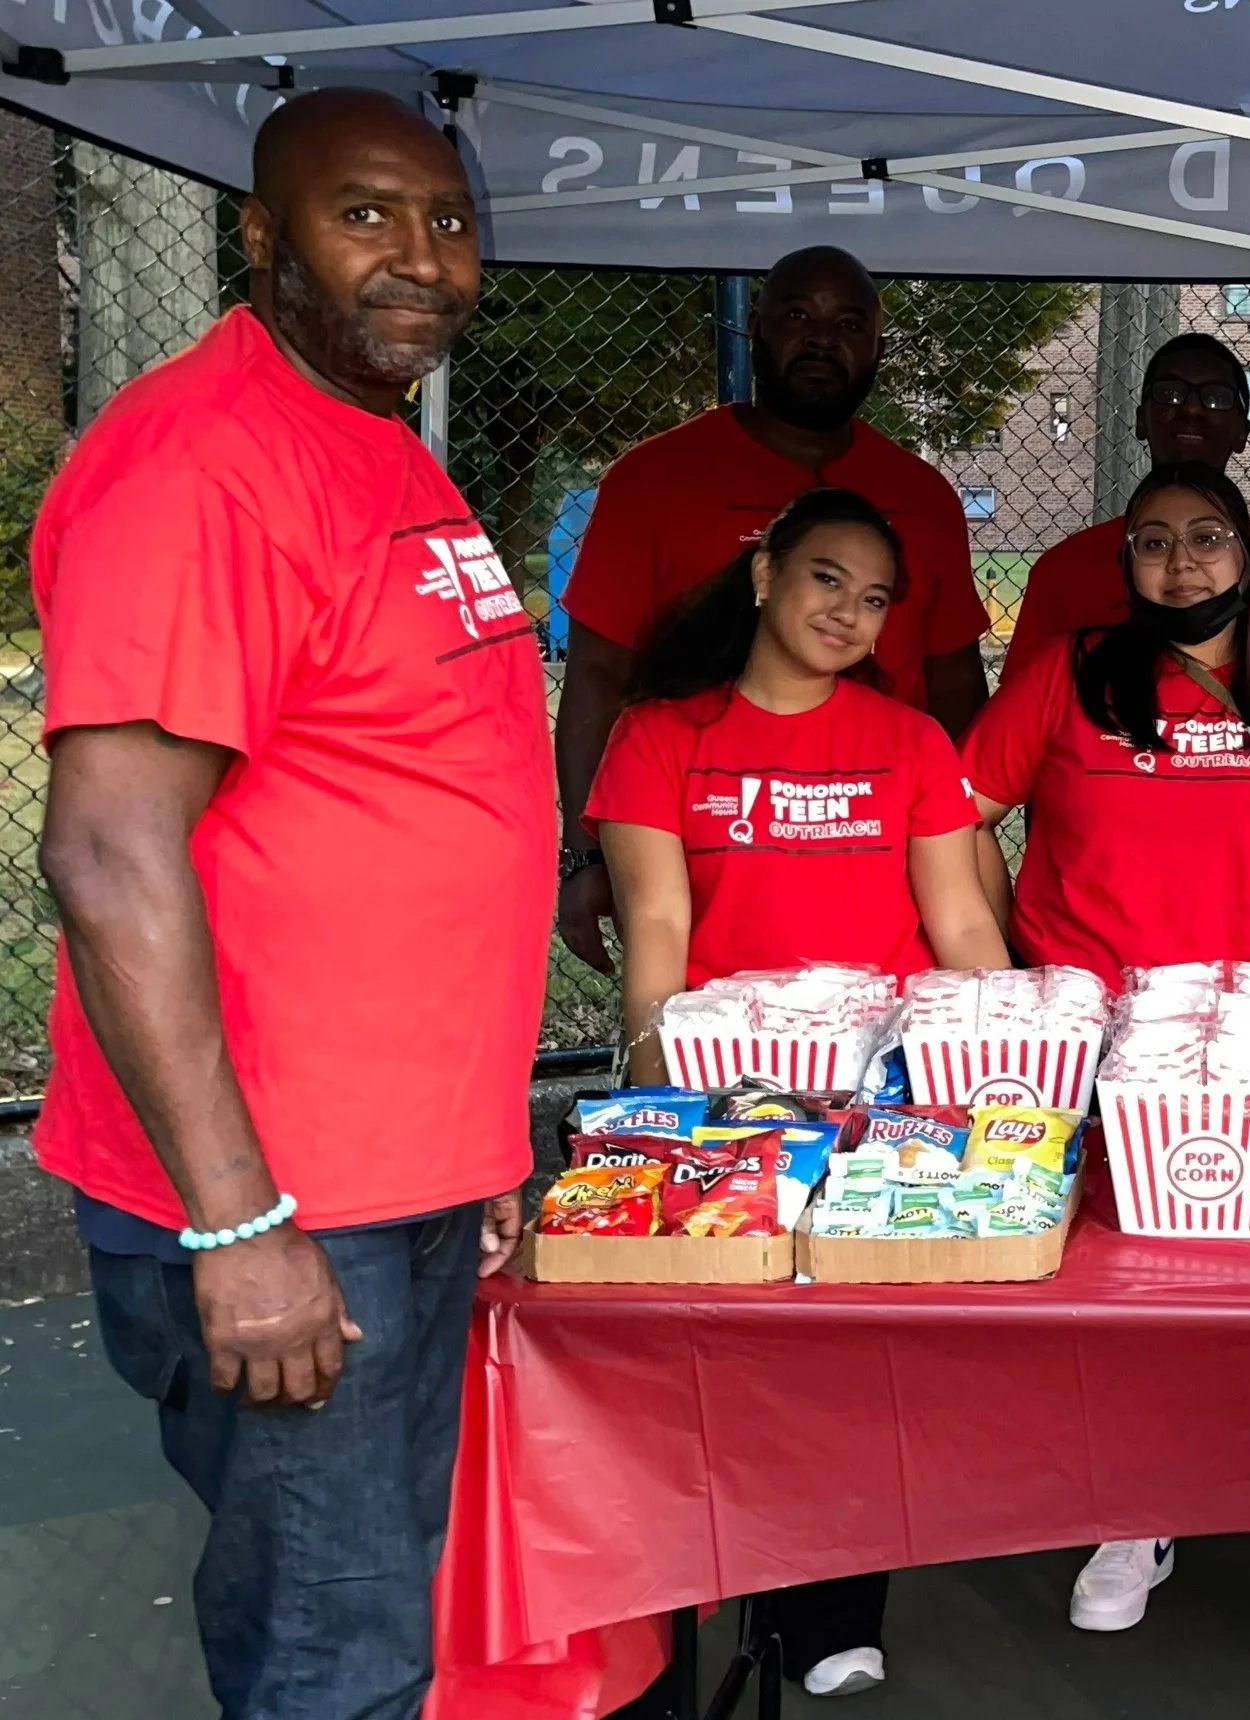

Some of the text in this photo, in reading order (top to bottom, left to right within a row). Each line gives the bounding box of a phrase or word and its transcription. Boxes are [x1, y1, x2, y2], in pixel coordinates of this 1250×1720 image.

[1172, 732, 1245, 753] TEEN
[769, 779, 873, 797] POMONOK
[769, 796, 850, 822] TEEN
[769, 820, 882, 840] OUTREACH
[985, 1093, 1023, 1106] POP
[870, 1118, 953, 1145] RUFFLES
[1184, 1152, 1225, 1166] POP
[1174, 1168, 1235, 1182] CORN
